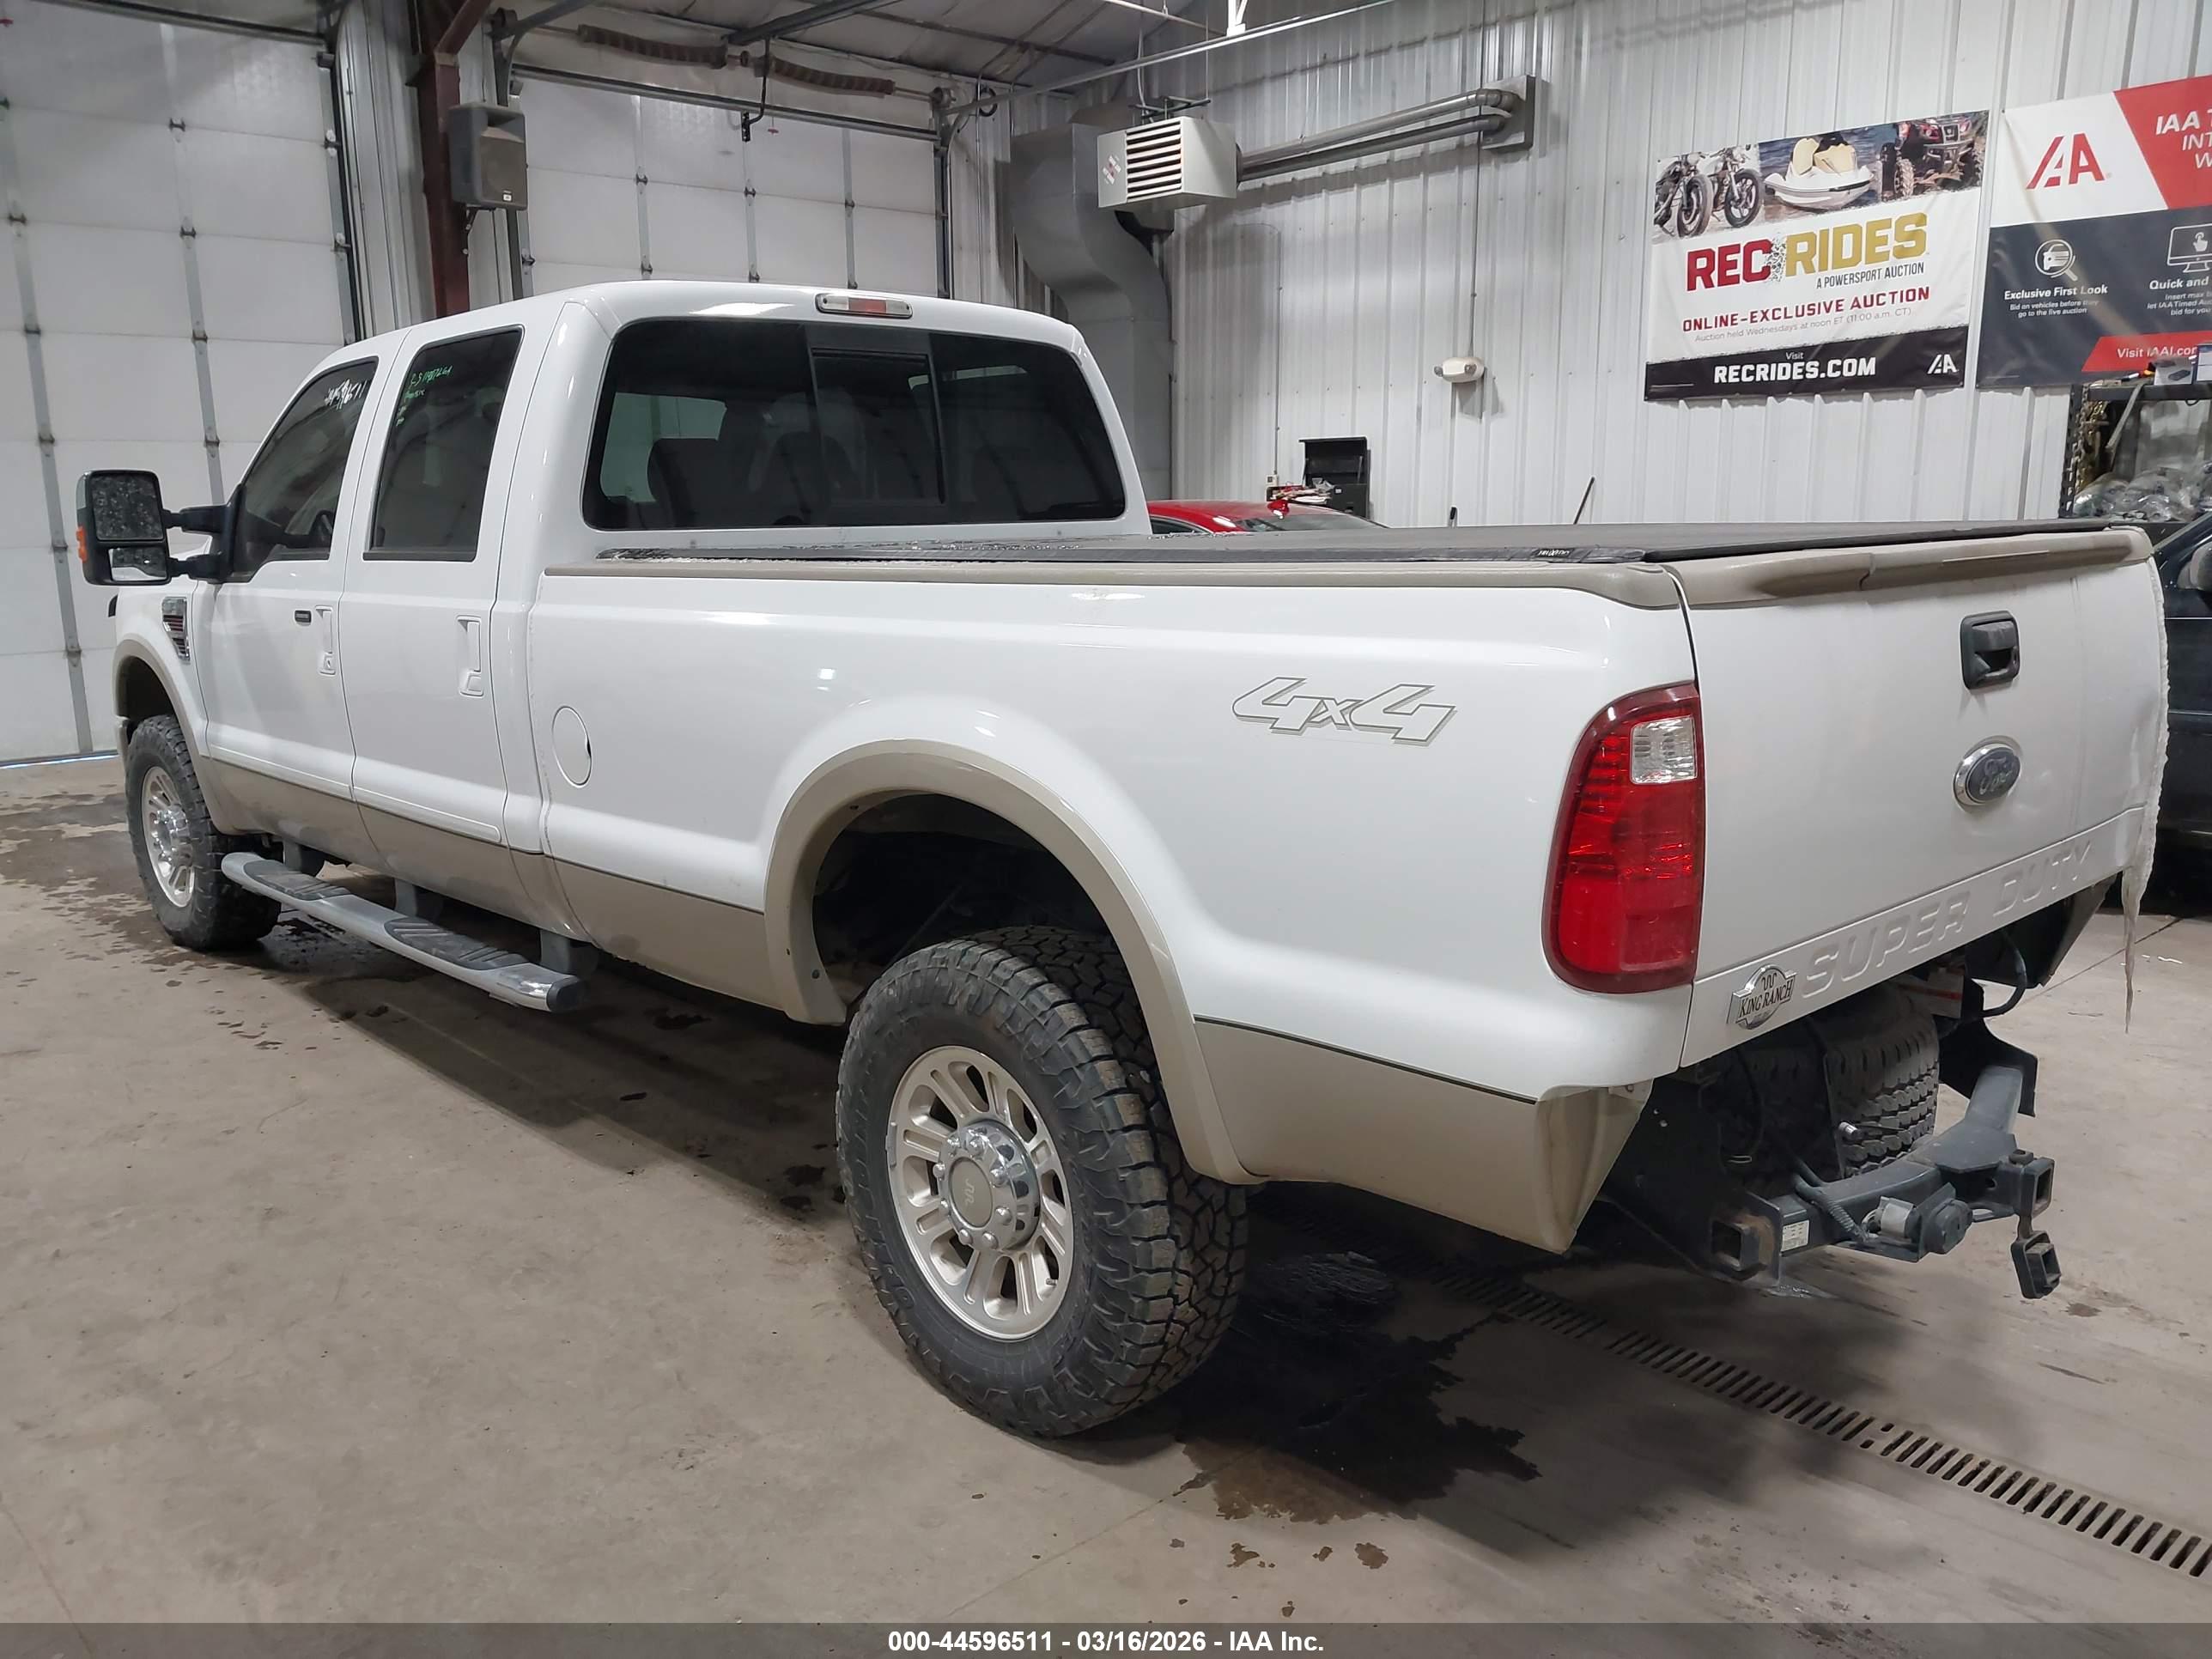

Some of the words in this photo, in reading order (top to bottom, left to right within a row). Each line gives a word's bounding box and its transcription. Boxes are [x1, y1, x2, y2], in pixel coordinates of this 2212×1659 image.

[2155, 111, 2200, 135] IAA
[1816, 277, 1822, 289] A
[1825, 268, 1882, 288] POWERSPORT
[1884, 262, 1924, 279] AUCTION
[2149, 278, 2184, 290] Quick
[2186, 276, 2209, 287] and
[2004, 288, 2051, 301] Exclusive
[2053, 286, 2077, 297] First
[2081, 284, 2108, 295] Look
[1683, 298, 1845, 332] ONLINE-EXCLUSIVE
[1850, 286, 1930, 311] AUCTION
[1695, 331, 1725, 342] Auction
[1727, 329, 1744, 338] held
[1747, 324, 1798, 336] Wednesdays
[1810, 319, 1831, 327] noon
[1833, 315, 1844, 325] ET
[1785, 352, 1803, 361] Visit
[2117, 347, 2144, 359] Visit
[1714, 357, 1876, 384] RECRIDES.COM
[1802, 890, 1972, 999] SUPER
[1991, 840, 2093, 917] DUTY
[1739, 994, 1763, 1018] KING
[1762, 979, 1793, 1009] RANCH
